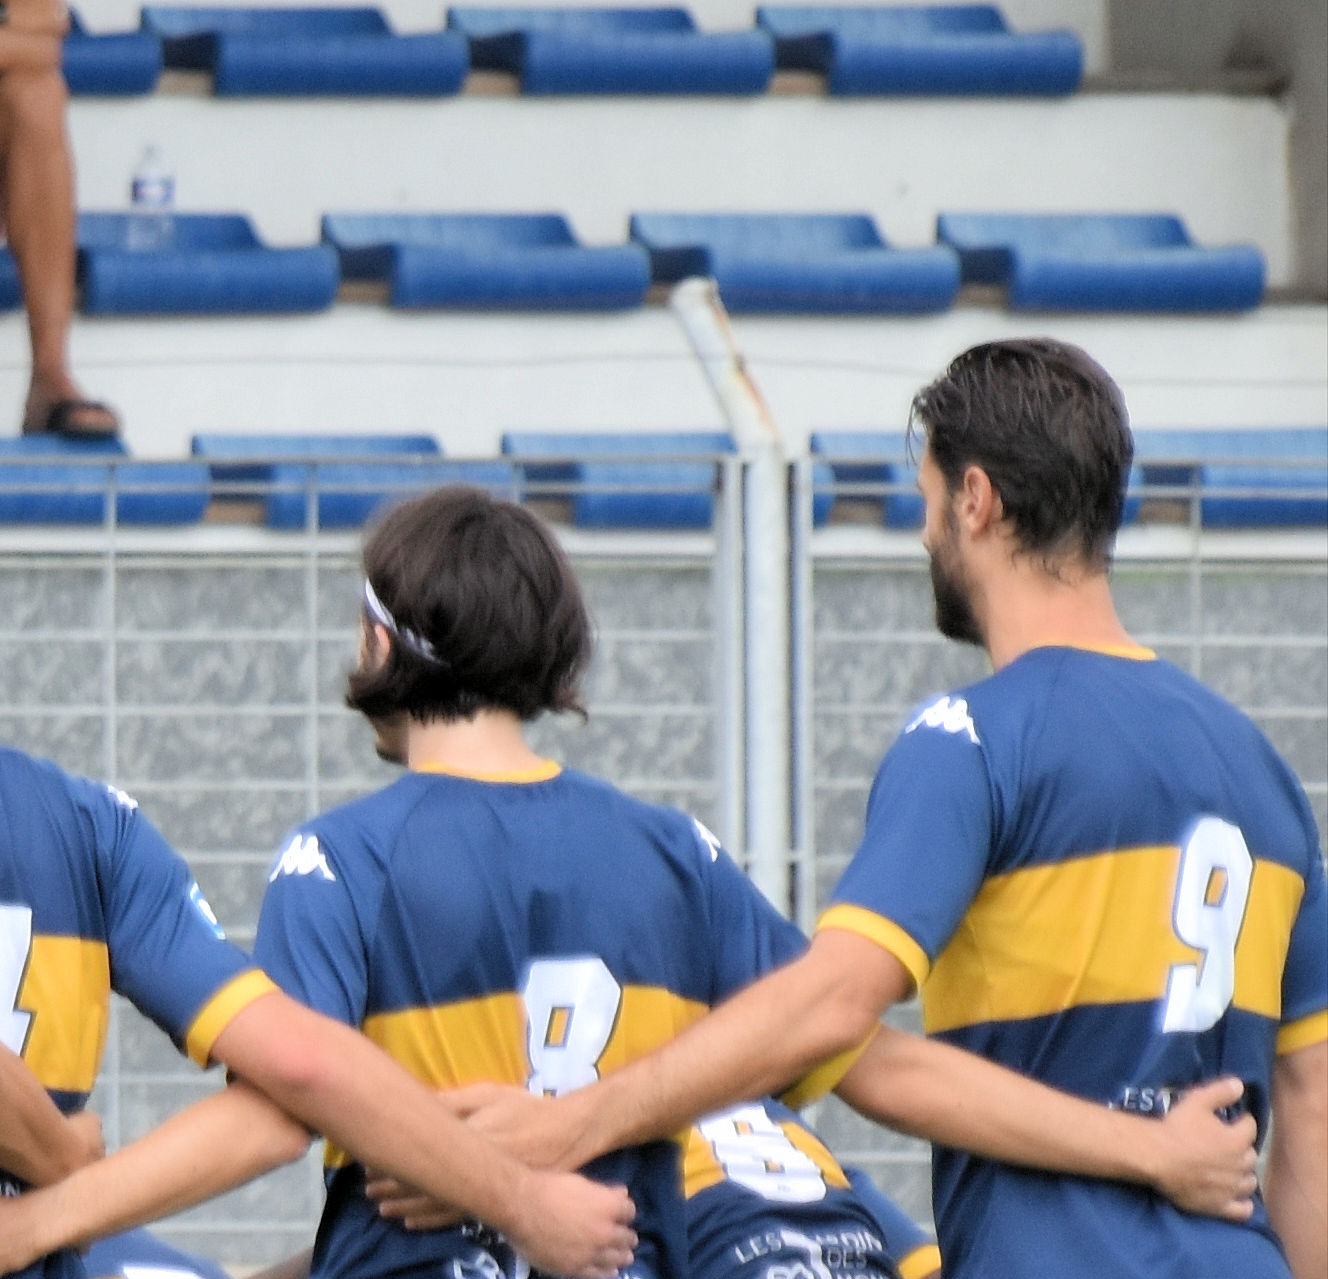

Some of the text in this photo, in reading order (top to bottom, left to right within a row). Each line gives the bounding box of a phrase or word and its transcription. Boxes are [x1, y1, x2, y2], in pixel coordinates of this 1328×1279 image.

[1162, 815, 1254, 1033] 9
[524, 957, 621, 1099] 8
[1109, 1086, 1156, 1112] ES
[734, 1231, 783, 1264] LES
